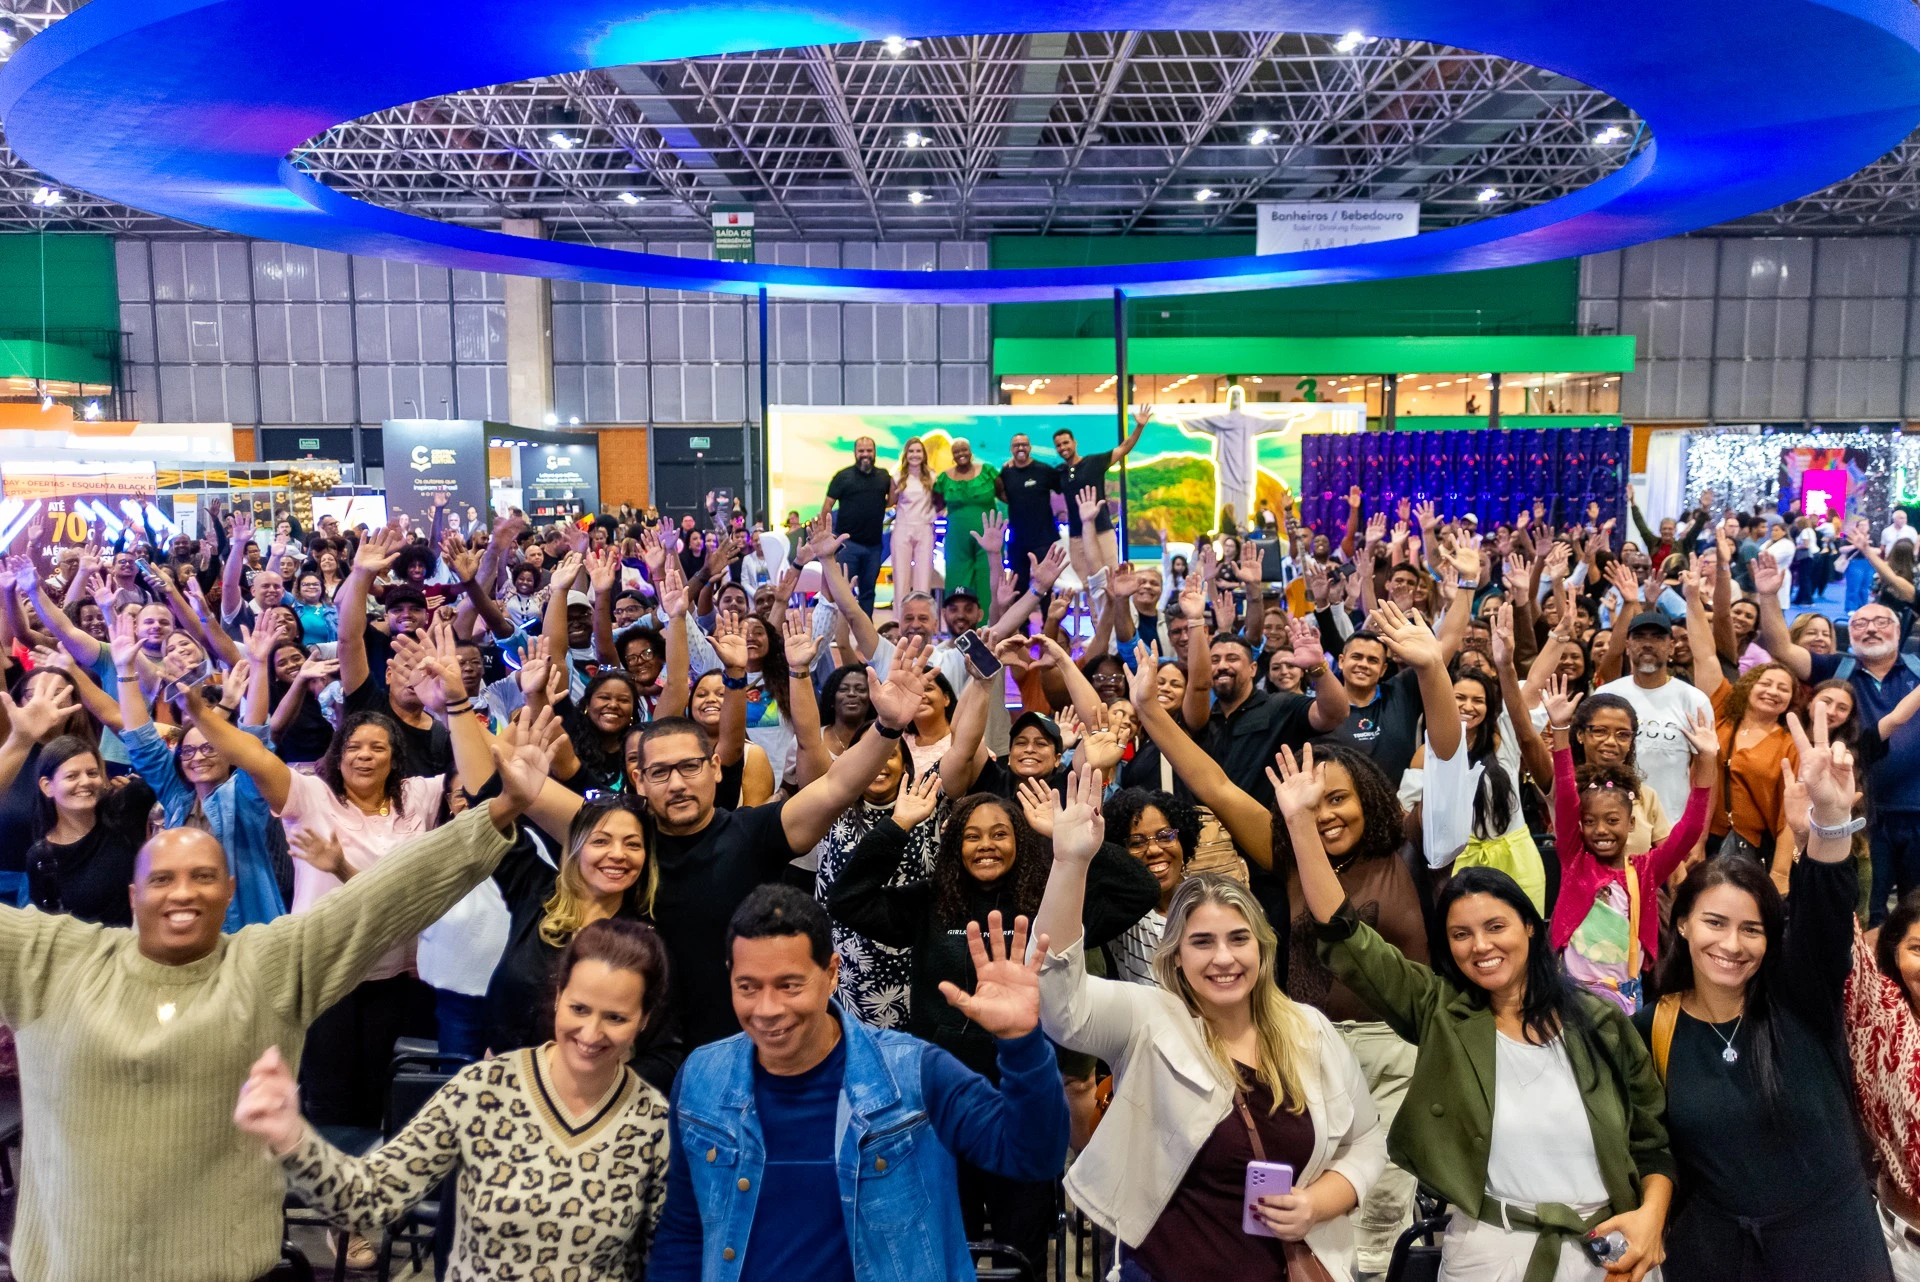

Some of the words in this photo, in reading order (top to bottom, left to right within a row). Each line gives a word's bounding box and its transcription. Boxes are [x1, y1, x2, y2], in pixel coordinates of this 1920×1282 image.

[1271, 211, 1328, 221] Banheiros
[1340, 209, 1404, 221] Bebedouro
[48, 500, 66, 511] ATÉ
[48, 512, 87, 542] 70
